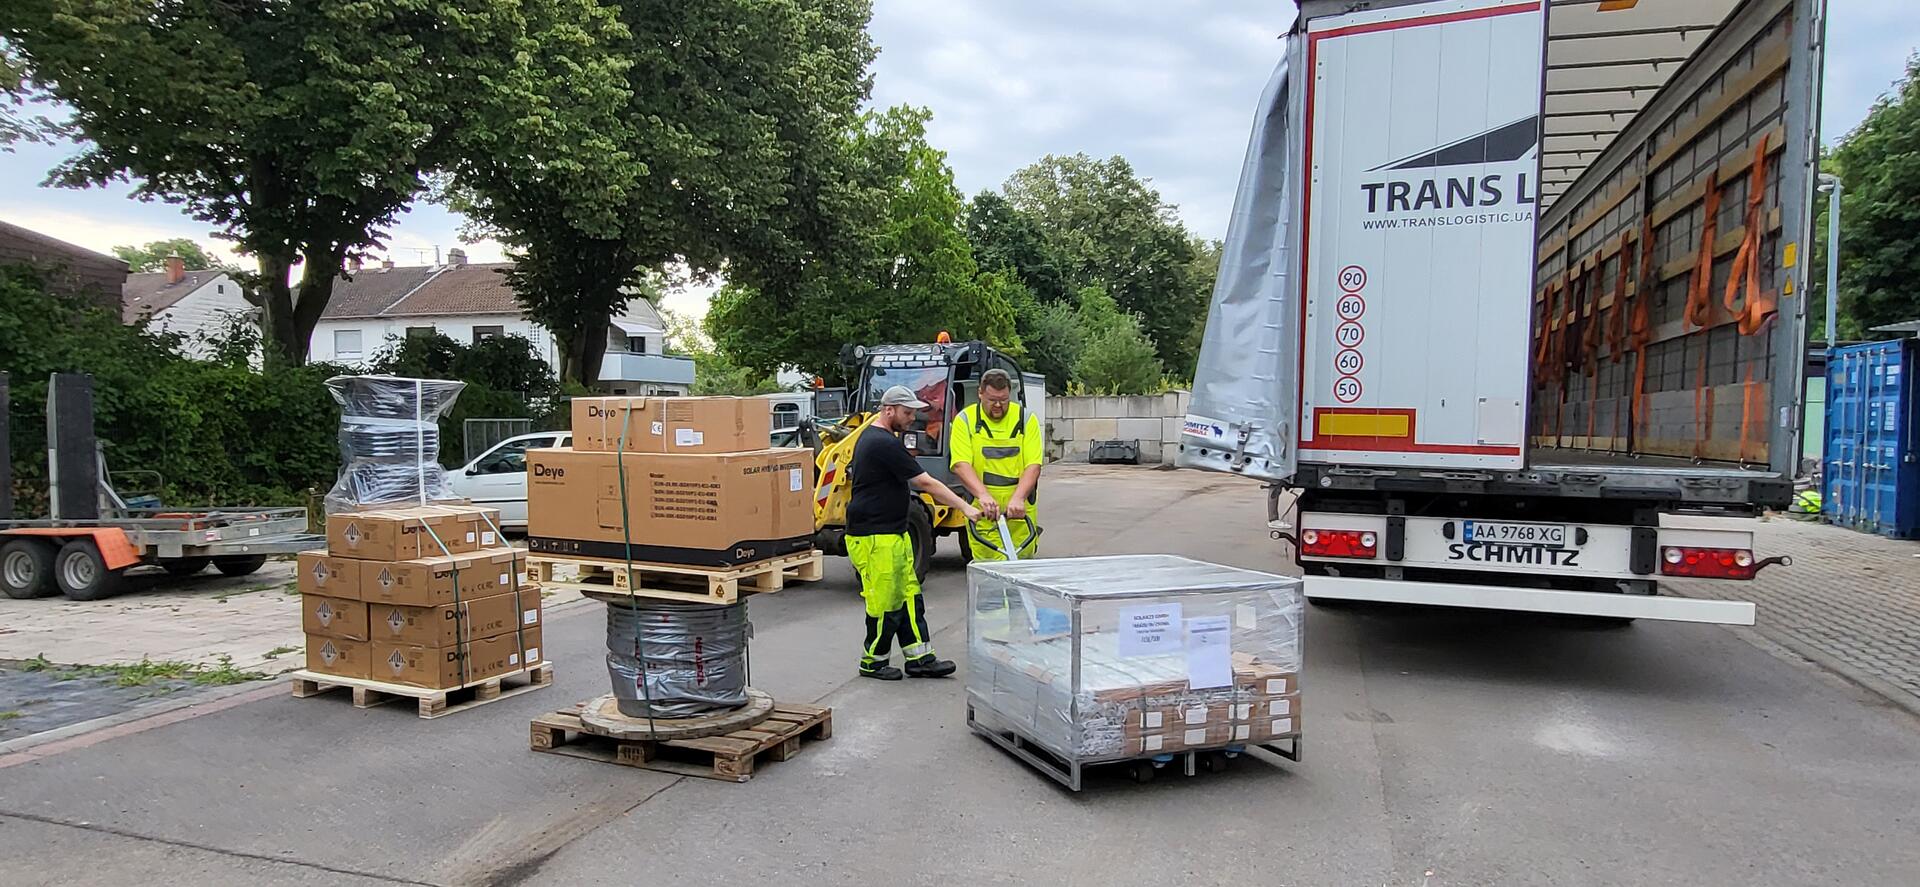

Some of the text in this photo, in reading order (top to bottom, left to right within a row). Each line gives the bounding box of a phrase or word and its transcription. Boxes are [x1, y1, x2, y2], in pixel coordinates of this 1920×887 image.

[1361, 175, 1503, 213] TRANS
[1363, 212, 1533, 231] WWW.TRANSLOGISTIC.UA
[1343, 272, 1362, 286] 90
[1341, 301, 1360, 314] 80
[1341, 328, 1359, 341] 70
[1340, 355, 1358, 369] 60
[1338, 383, 1357, 396] 50
[588, 405, 616, 420] Deye
[534, 463, 565, 480] Deye
[402, 524, 427, 535] Dee
[1475, 525, 1562, 542] AA 9768 XG
[736, 548, 755, 559] Deye
[1448, 543, 1580, 566] SCHMITZ
[445, 608, 467, 620] Dey
